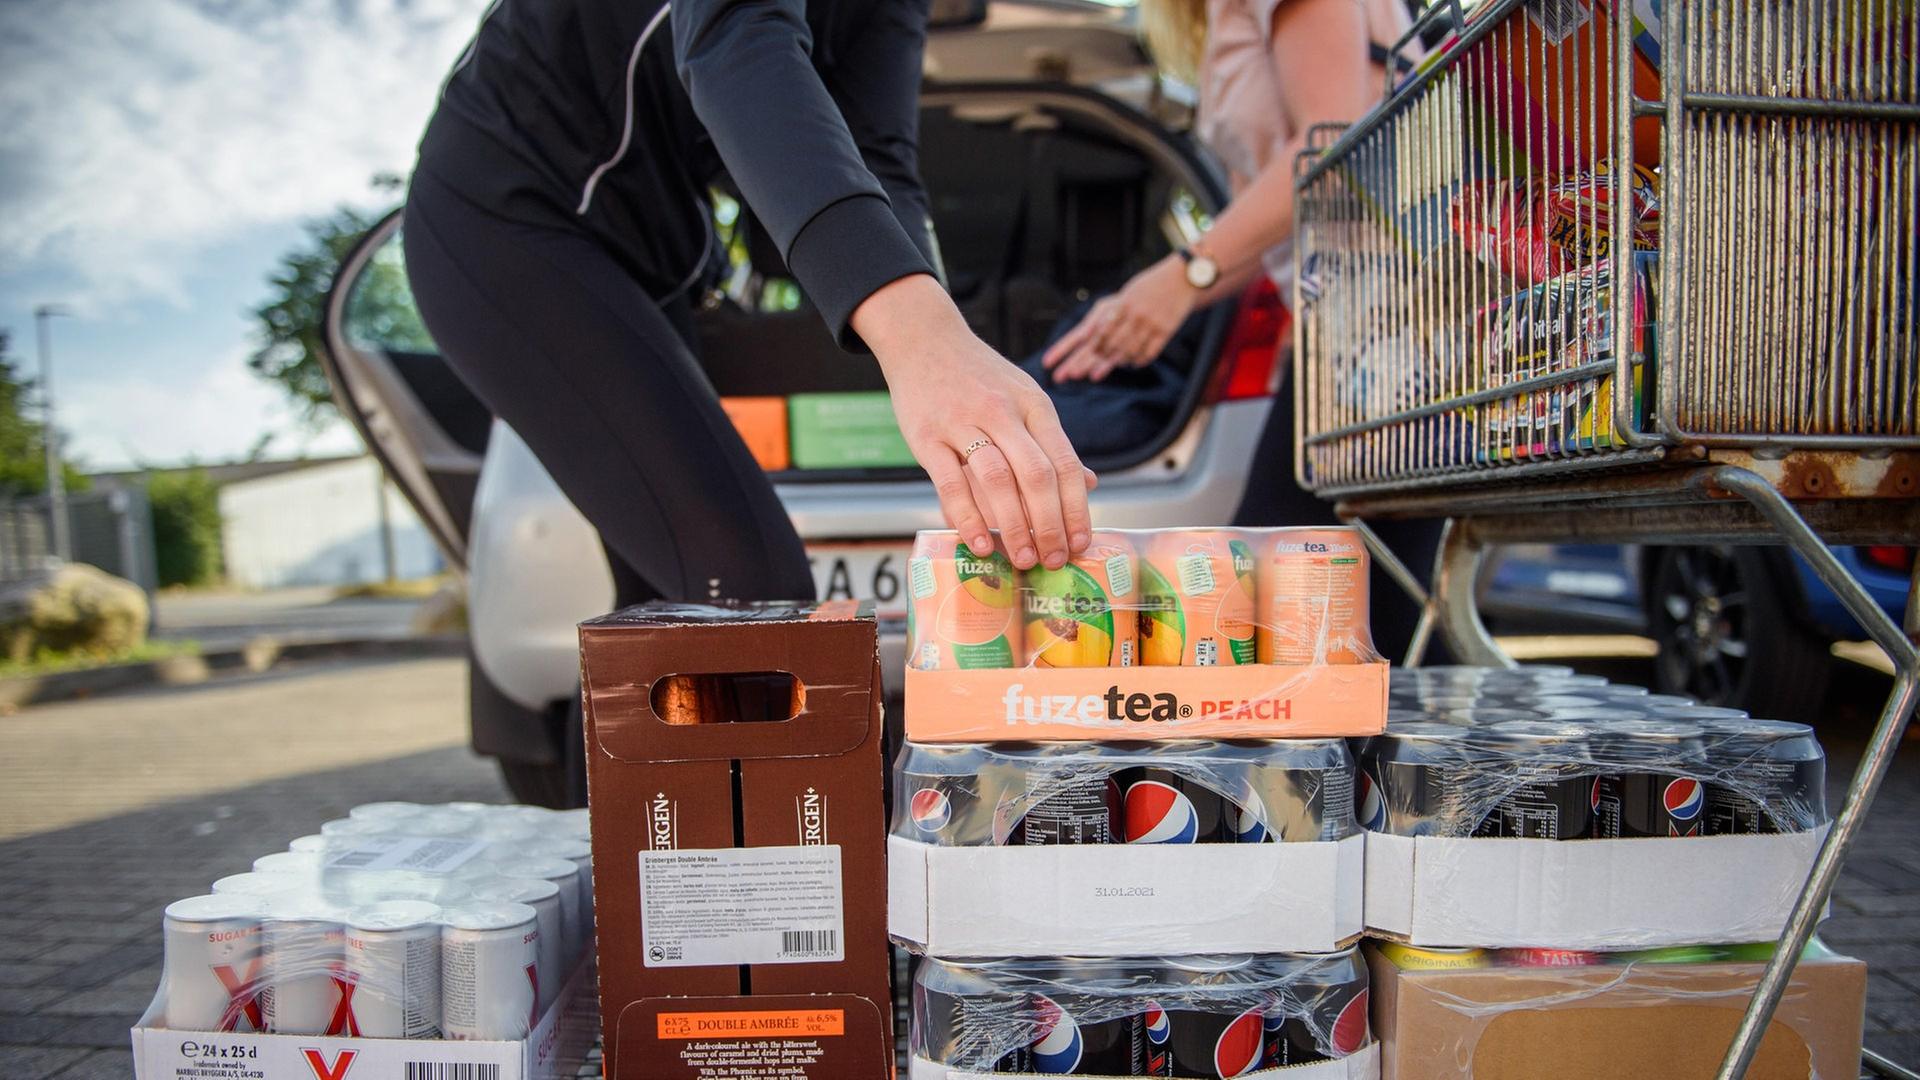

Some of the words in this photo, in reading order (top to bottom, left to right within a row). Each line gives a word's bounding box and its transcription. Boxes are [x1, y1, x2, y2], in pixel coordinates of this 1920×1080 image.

[1201, 699, 1291, 721] PEACH
[1095, 887, 1155, 897] 31.01.2021
[1542, 951, 1586, 966] TASTE
[698, 1020, 747, 1031] DOUBLE
[750, 1016, 799, 1030] AMBRÉE
[686, 1042, 693, 1050] A
[694, 1041, 740, 1050] dark-coloured
[741, 1041, 751, 1049] ale
[752, 1041, 769, 1049] with
[202, 1044, 217, 1058] 24
[220, 1048, 228, 1058] x
[231, 1046, 246, 1059] 25
[248, 1046, 258, 1059] cl
[680, 1050, 709, 1058] flavours
[719, 1049, 745, 1057] caramel
[747, 1049, 760, 1057] and
[761, 1048, 779, 1057] dried
[805, 1047, 824, 1056] made
[222, 1061, 238, 1069] owned
[239, 1061, 247, 1070] by
[764, 1057, 780, 1066] hops
[781, 1056, 795, 1064] and
